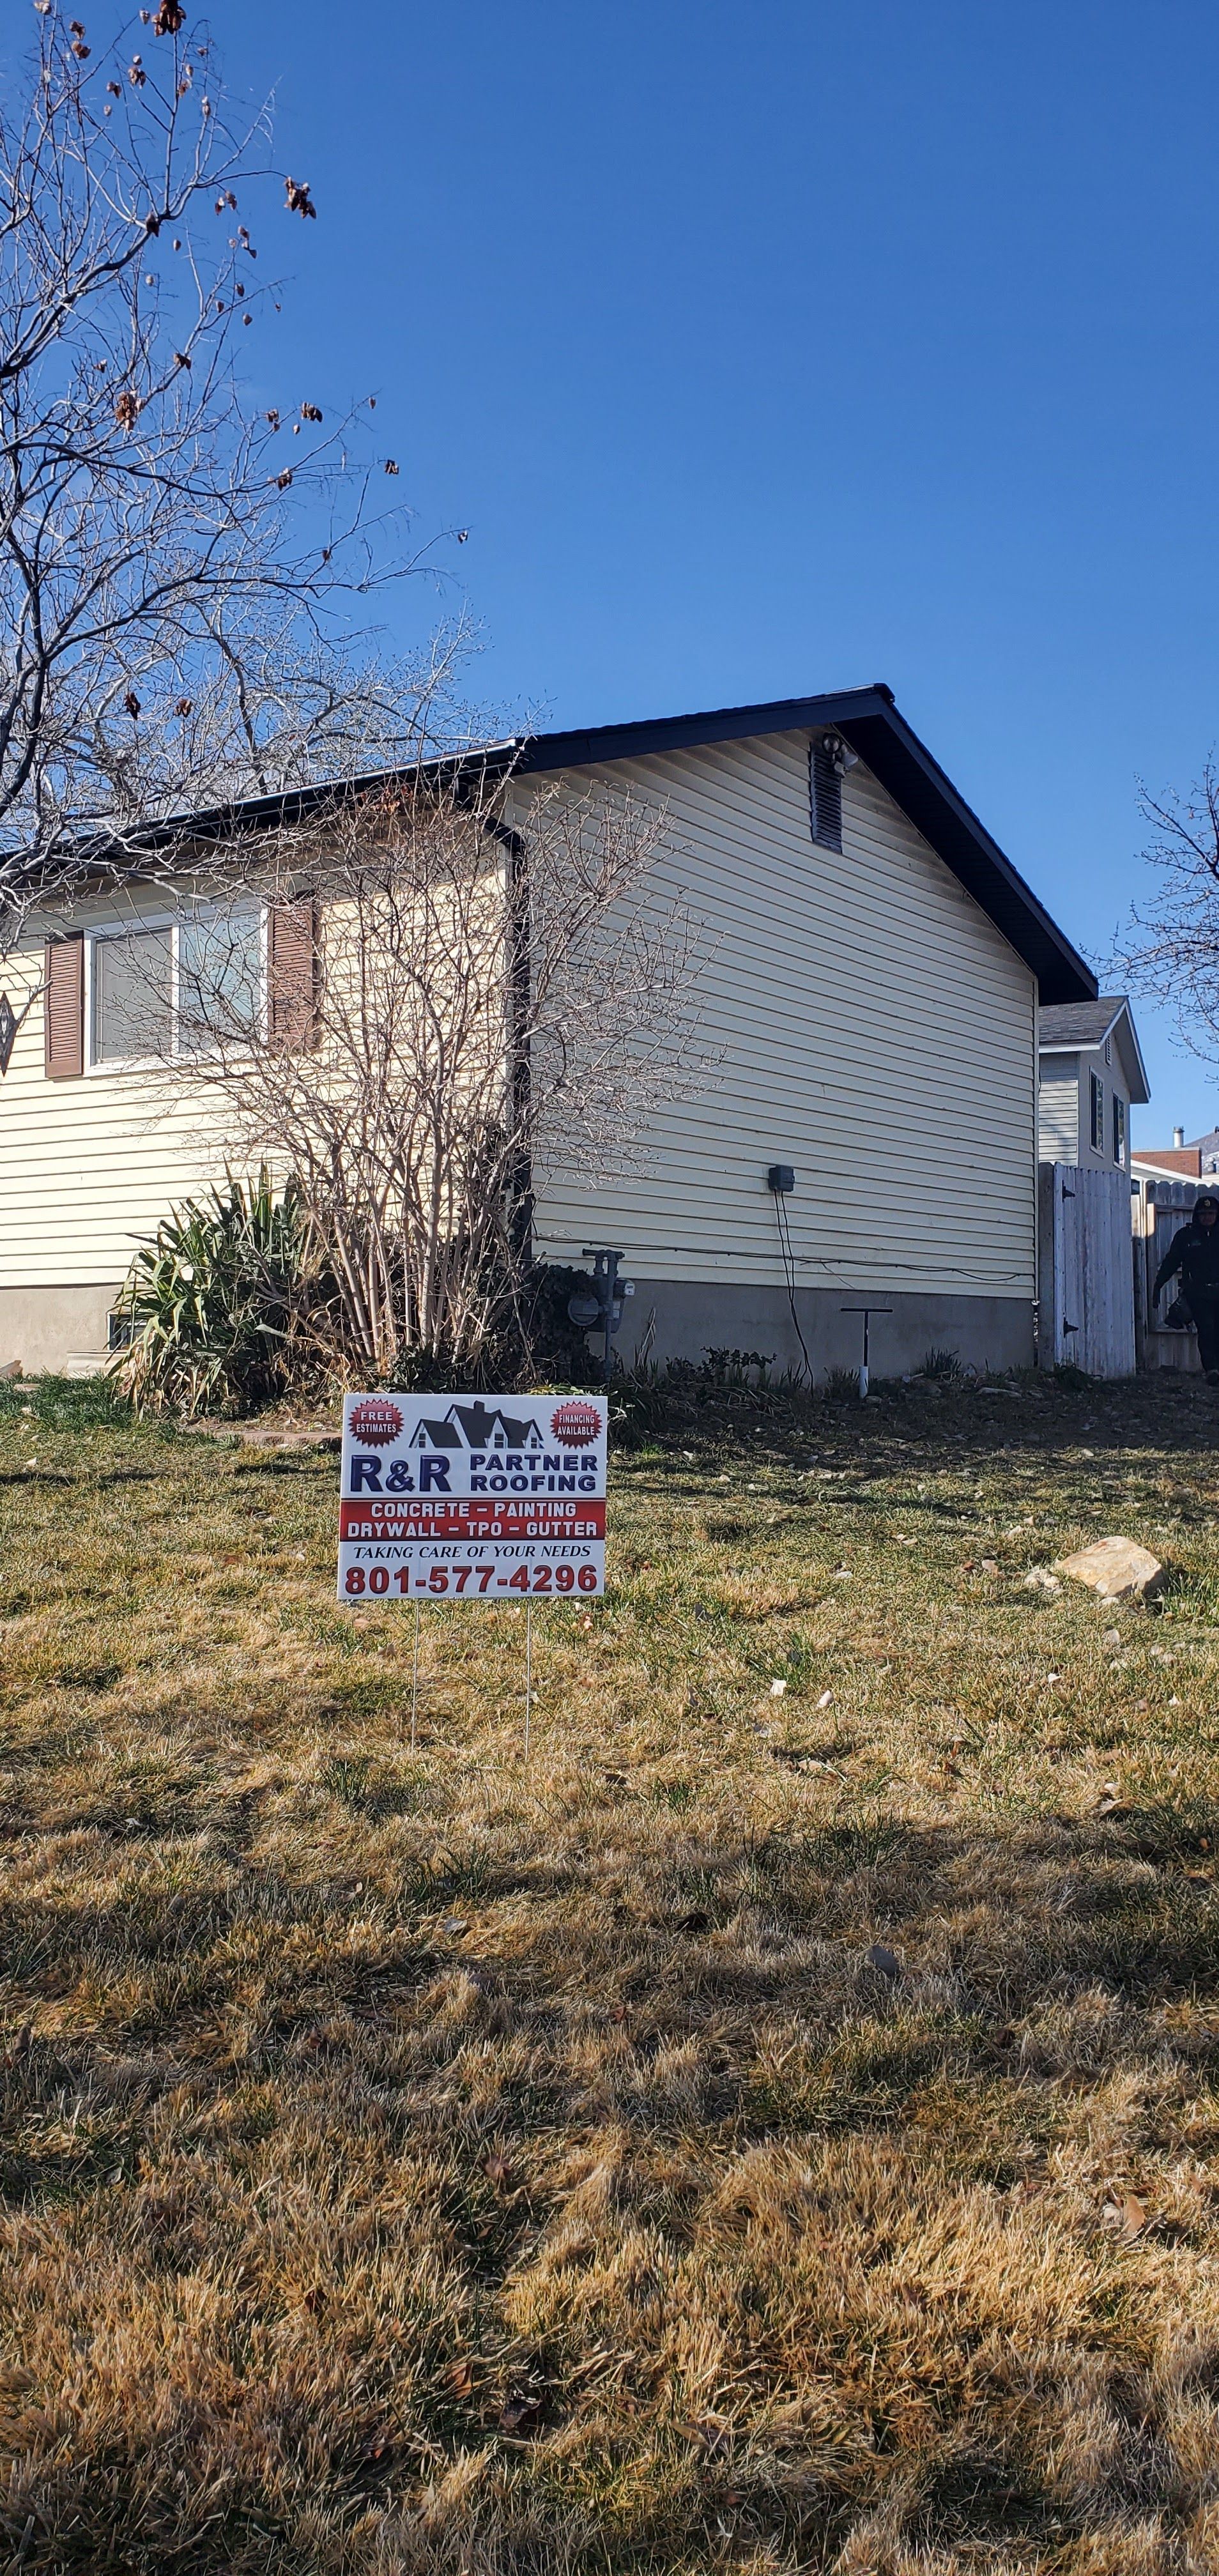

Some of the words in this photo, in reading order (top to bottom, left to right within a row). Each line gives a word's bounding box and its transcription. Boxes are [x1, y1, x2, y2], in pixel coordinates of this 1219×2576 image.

[360, 1411, 393, 1420] FREE
[559, 1415, 595, 1424] FINANCING
[356, 1424, 397, 1433] ESTIMATES
[557, 1426, 595, 1436] AVAILABLE
[470, 1454, 598, 1471] PARTNER
[350, 1454, 452, 1492] R&R
[470, 1475, 596, 1491] ROOFING
[371, 1503, 470, 1517] CONCRETE
[494, 1502, 576, 1517] PAINTING
[348, 1522, 441, 1537] DRYWALL
[467, 1522, 502, 1537] TPO
[526, 1522, 597, 1536] GUTTER
[353, 1547, 413, 1559] TAKING
[419, 1546, 462, 1558] CARE
[467, 1546, 488, 1558] OF
[494, 1546, 535, 1557] YOUR
[541, 1545, 591, 1556] NEEDS
[345, 1565, 597, 1595] 801-577-4296
